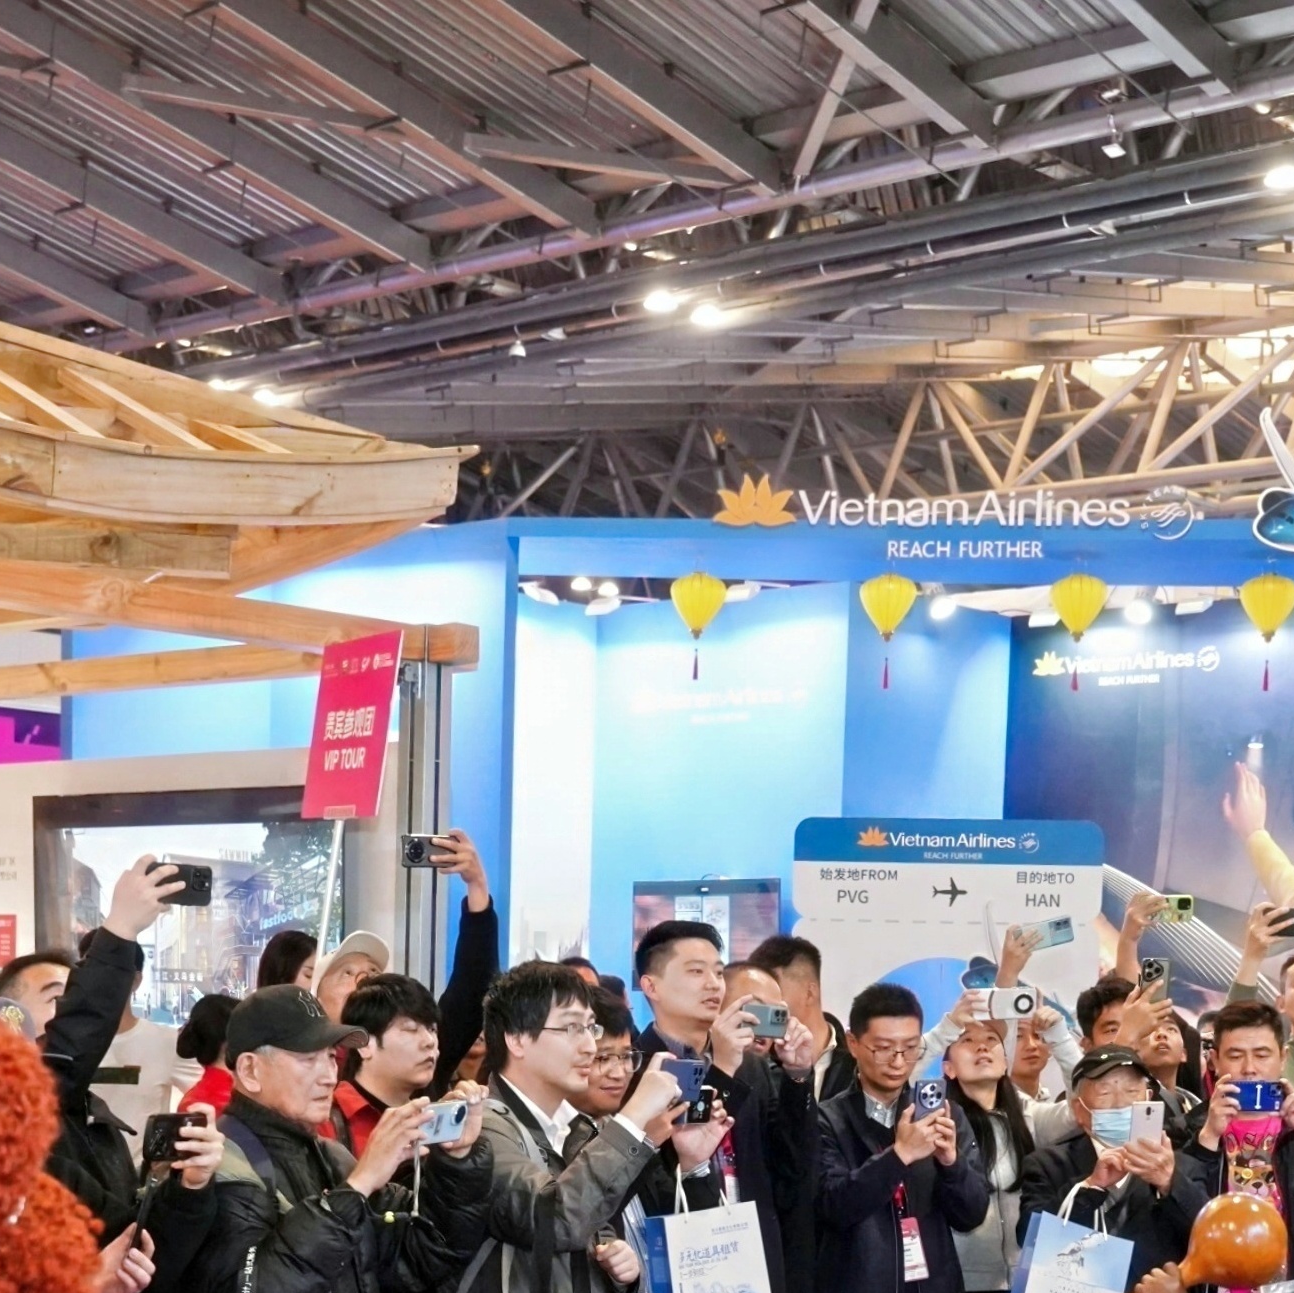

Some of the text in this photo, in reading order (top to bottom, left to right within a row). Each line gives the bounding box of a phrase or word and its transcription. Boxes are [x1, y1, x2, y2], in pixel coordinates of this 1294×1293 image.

[798, 488, 1132, 527] Vietnam Airlines
[887, 541, 1043, 558] REACH FURTHER
[323, 706, 376, 741] 贵宾参观团
[324, 747, 366, 771] VIP TOUR
[889, 832, 955, 848] Vietnam
[957, 832, 1016, 848] Airlines
[923, 851, 983, 860] REACH FURTHER
[820, 868, 898, 881] 始发地FROM
[1016, 871, 1075, 884] 目的地TO
[836, 889, 869, 904] PVG
[1025, 893, 1061, 907] HAN
